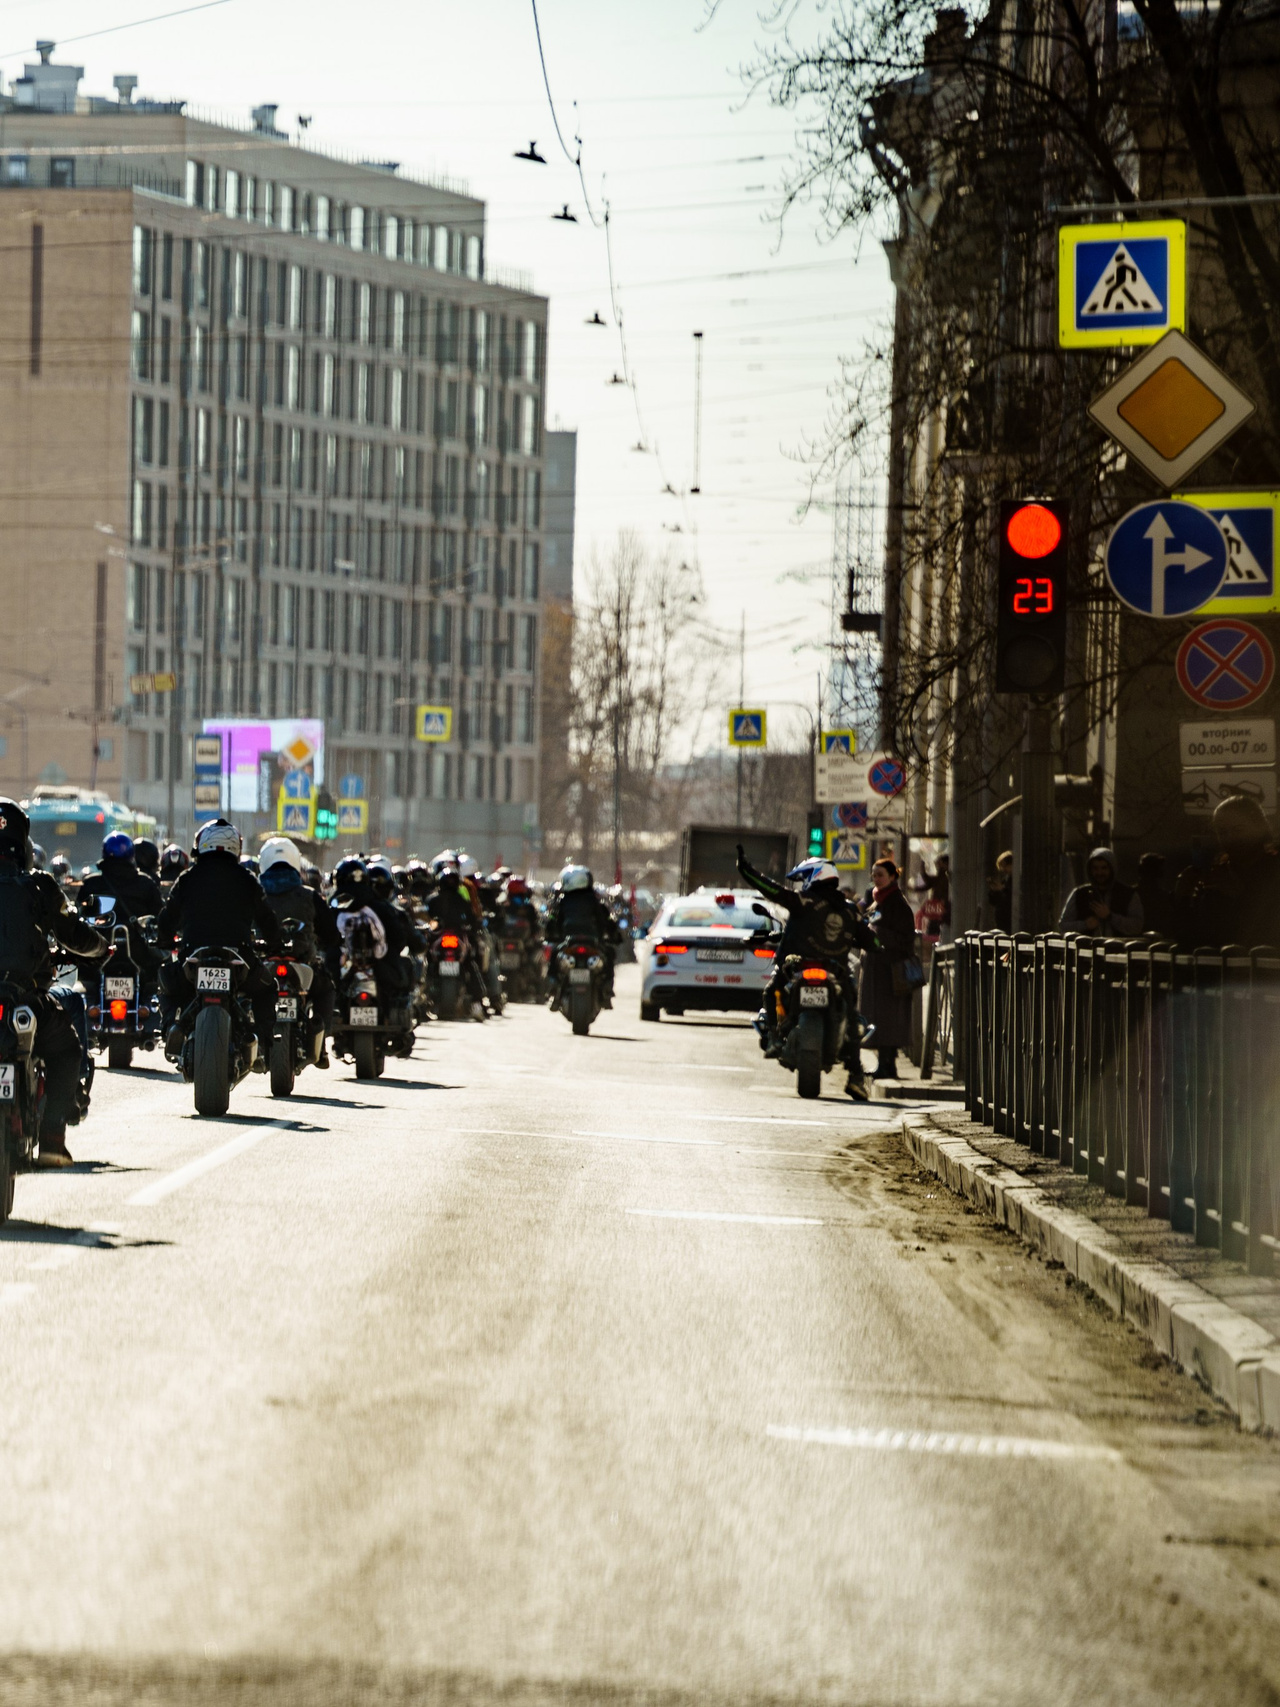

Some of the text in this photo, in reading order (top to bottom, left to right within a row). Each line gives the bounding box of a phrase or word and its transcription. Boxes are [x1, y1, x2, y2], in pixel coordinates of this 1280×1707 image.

[1013, 578, 1053, 614] 23
[1202, 729, 1252, 739] вторник
[203, 969, 226, 977] 1625
[217, 981, 228, 989] 78
